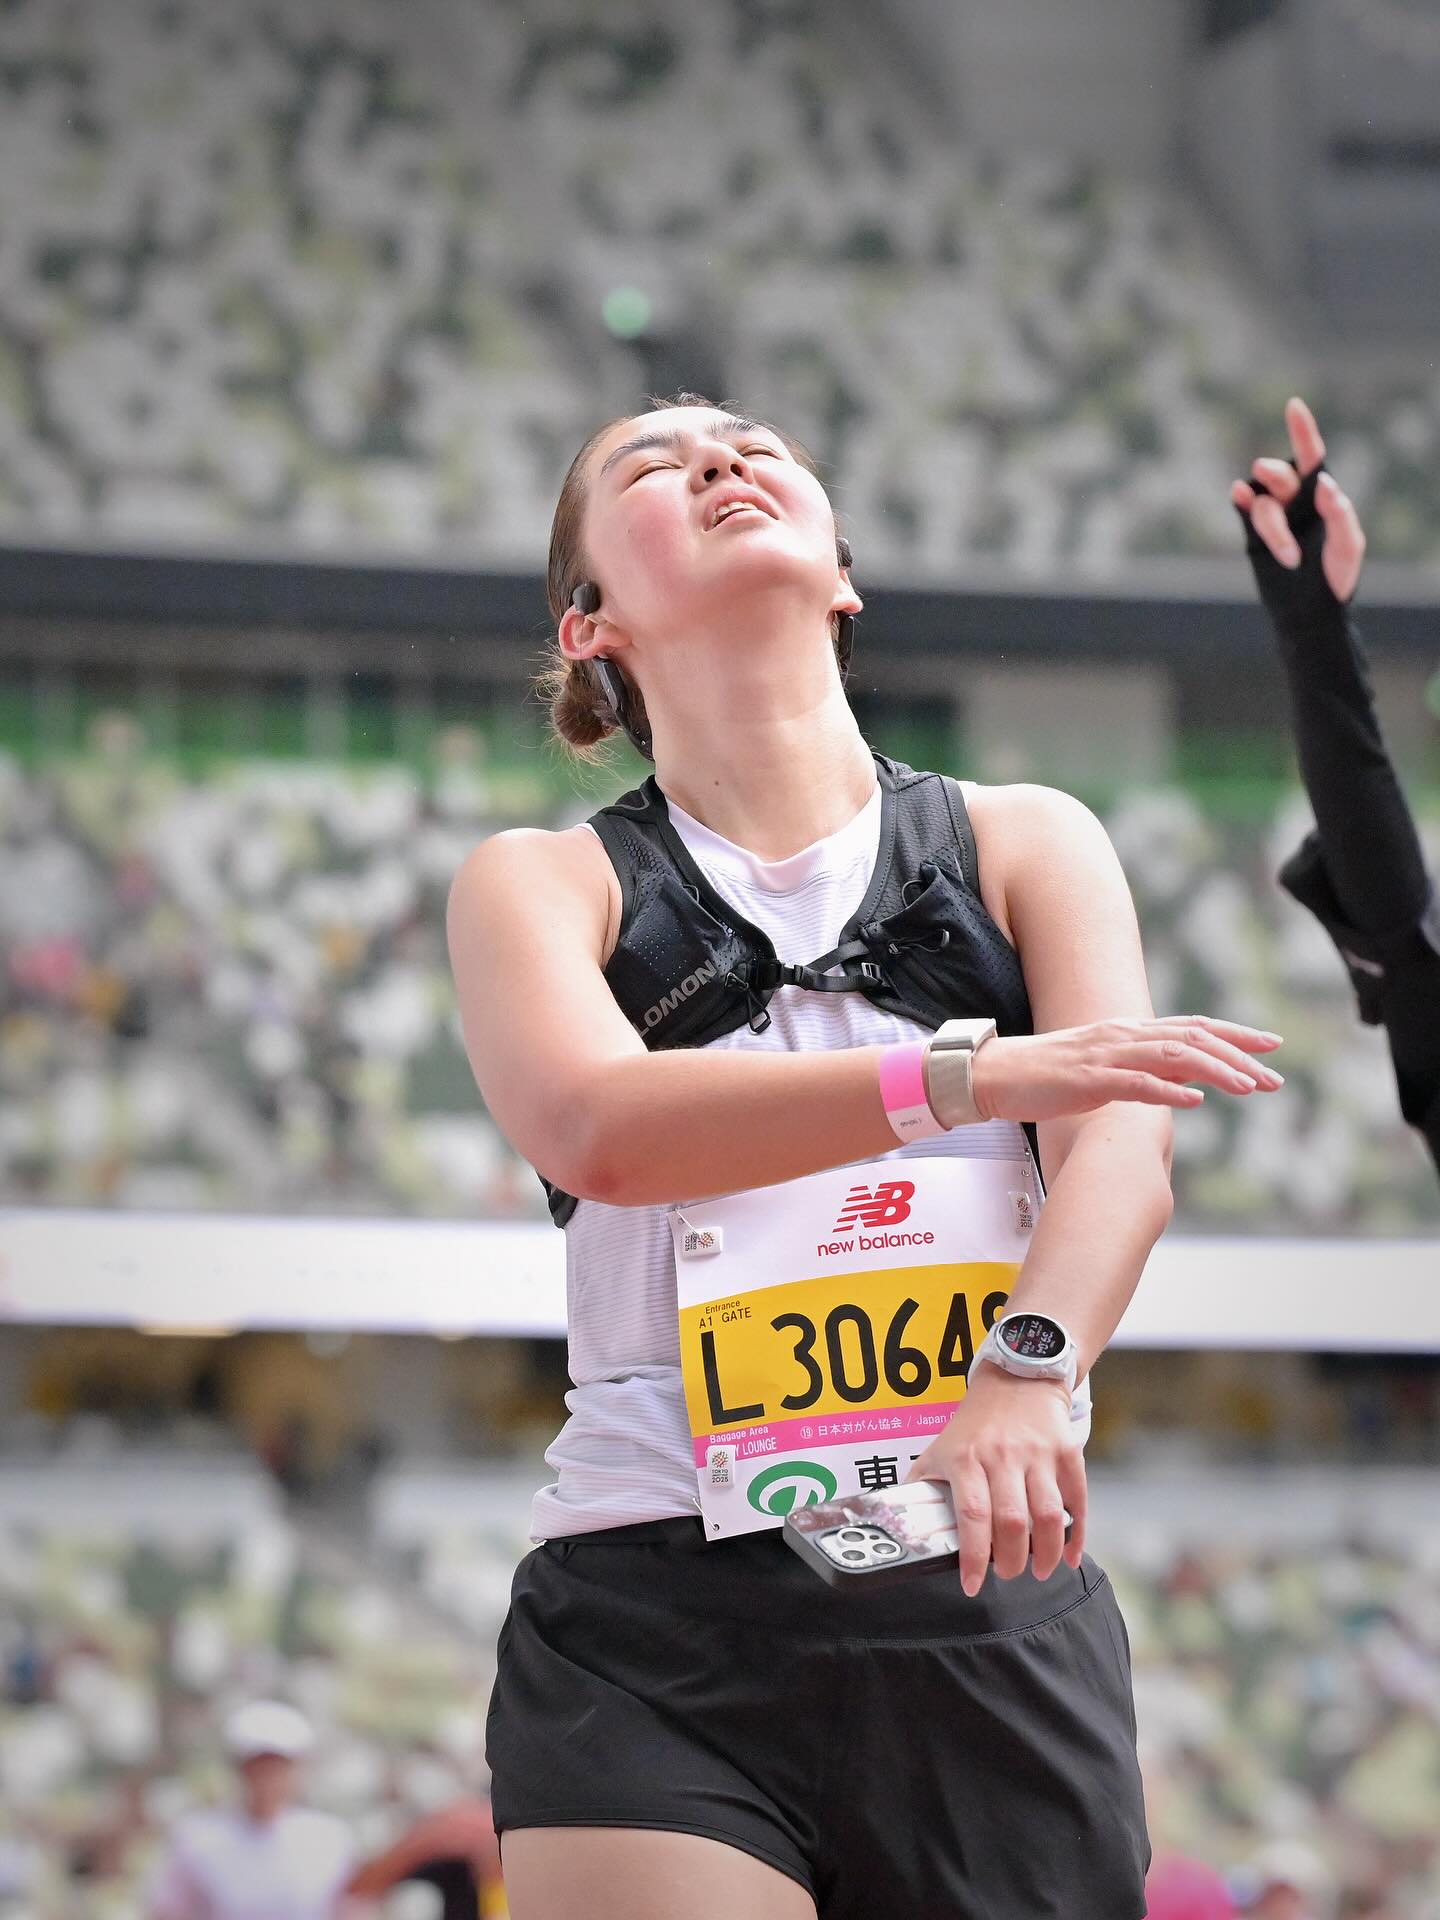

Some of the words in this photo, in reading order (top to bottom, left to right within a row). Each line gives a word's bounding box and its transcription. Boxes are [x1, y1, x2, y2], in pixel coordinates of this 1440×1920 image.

[817, 1241, 855, 1257] new
[858, 1231, 935, 1251] balance
[699, 1315, 713, 1329] A1
[721, 1306, 752, 1323] GATE
[705, 1300, 741, 1314] Entrance
[709, 1429, 746, 1444] Baggage
[749, 1425, 769, 1437] Area
[818, 1416, 902, 1437] 日本対がん協会
[916, 1413, 947, 1427] Japan
[743, 1437, 777, 1456] LOUNGE
